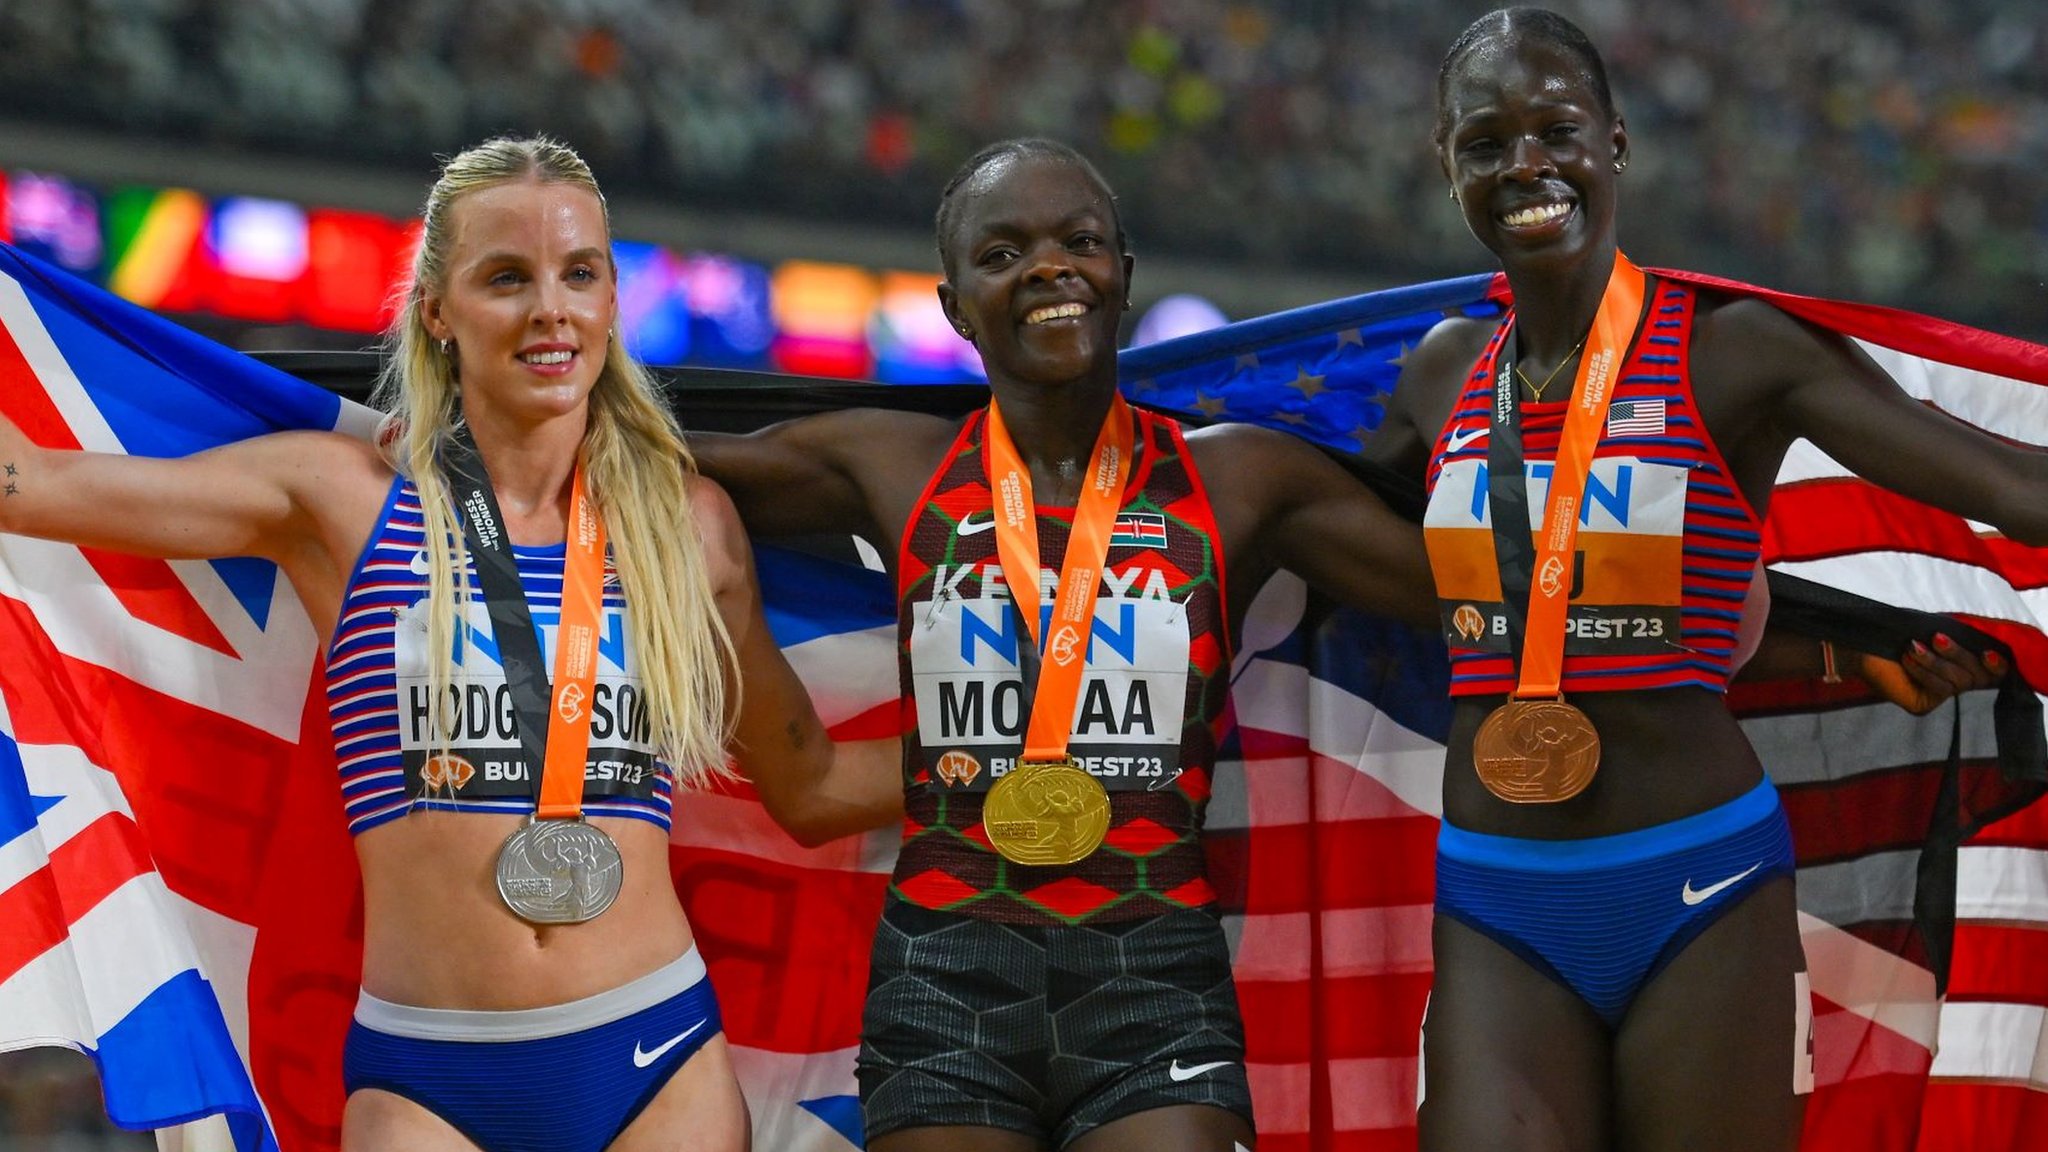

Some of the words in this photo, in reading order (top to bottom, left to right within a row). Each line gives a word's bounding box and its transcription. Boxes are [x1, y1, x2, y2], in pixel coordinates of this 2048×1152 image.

[1504, 362, 1512, 413] WONDER
[1582, 352, 1601, 409] WITNESS
[1593, 348, 1613, 403] WONDER
[1095, 446, 1110, 491] WITNESS
[1107, 446, 1119, 487] WONDER
[472, 490, 499, 541] WONDER
[1000, 478, 1017, 527] WITNESS
[1008, 471, 1026, 520] WONDER
[465, 499, 491, 548] WITNESS
[961, 604, 1134, 666] NN
[1492, 616, 1628, 638] BPEST
[1632, 617, 1664, 638] 23
[410, 682, 651, 744] HODGSON
[939, 679, 1155, 738] MOAA
[485, 760, 623, 782] BUEST
[623, 763, 644, 784] 23
[1137, 757, 1162, 777] 23
